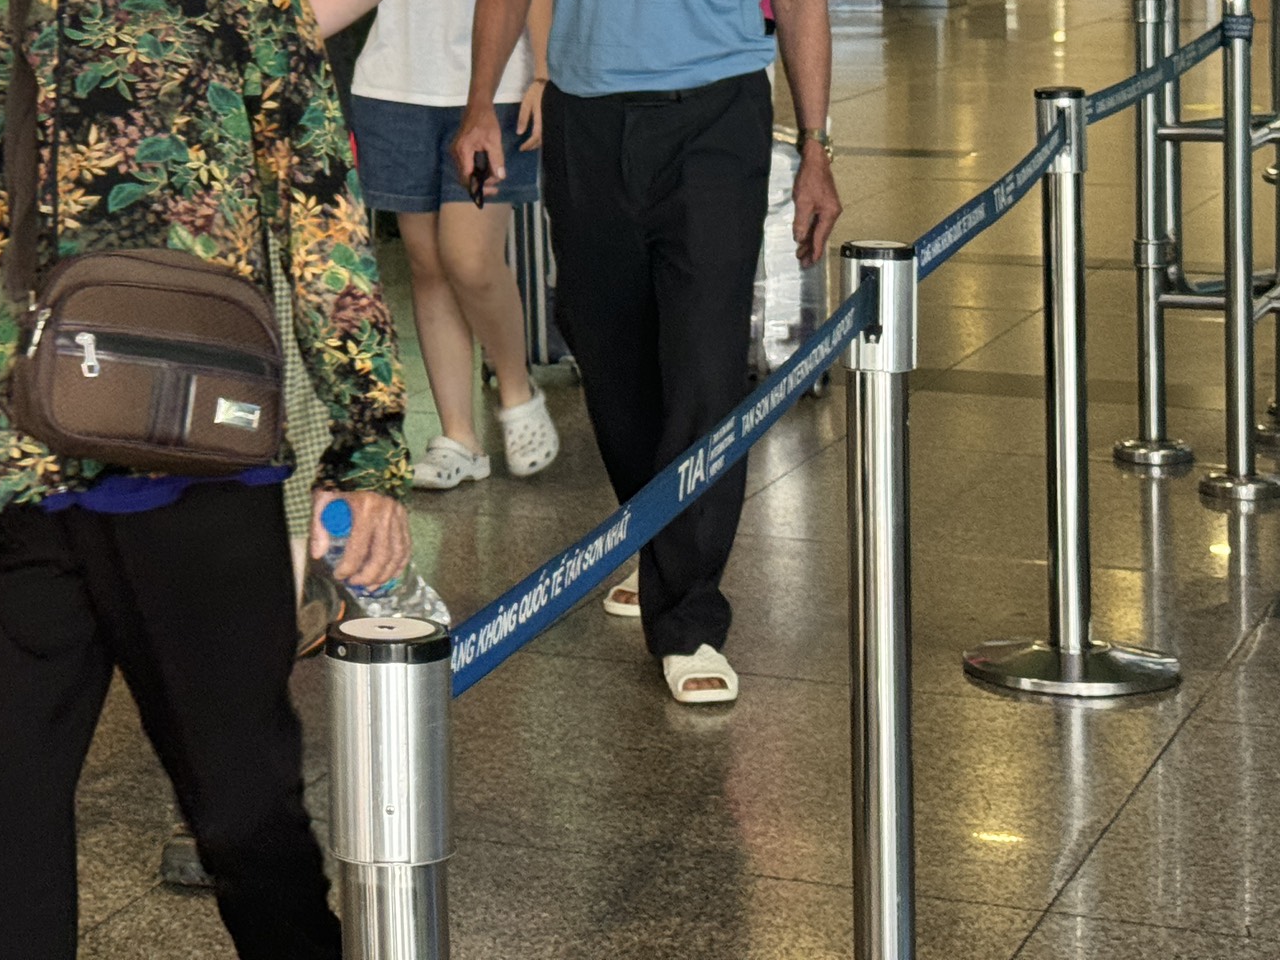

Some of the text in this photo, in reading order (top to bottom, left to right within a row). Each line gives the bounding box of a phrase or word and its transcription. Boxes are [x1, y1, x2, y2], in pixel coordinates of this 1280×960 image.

[678, 448, 705, 502] TIA
[476, 603, 518, 658] KHÔNG
[518, 569, 550, 625] QUỐC
[550, 553, 569, 600] TẾ
